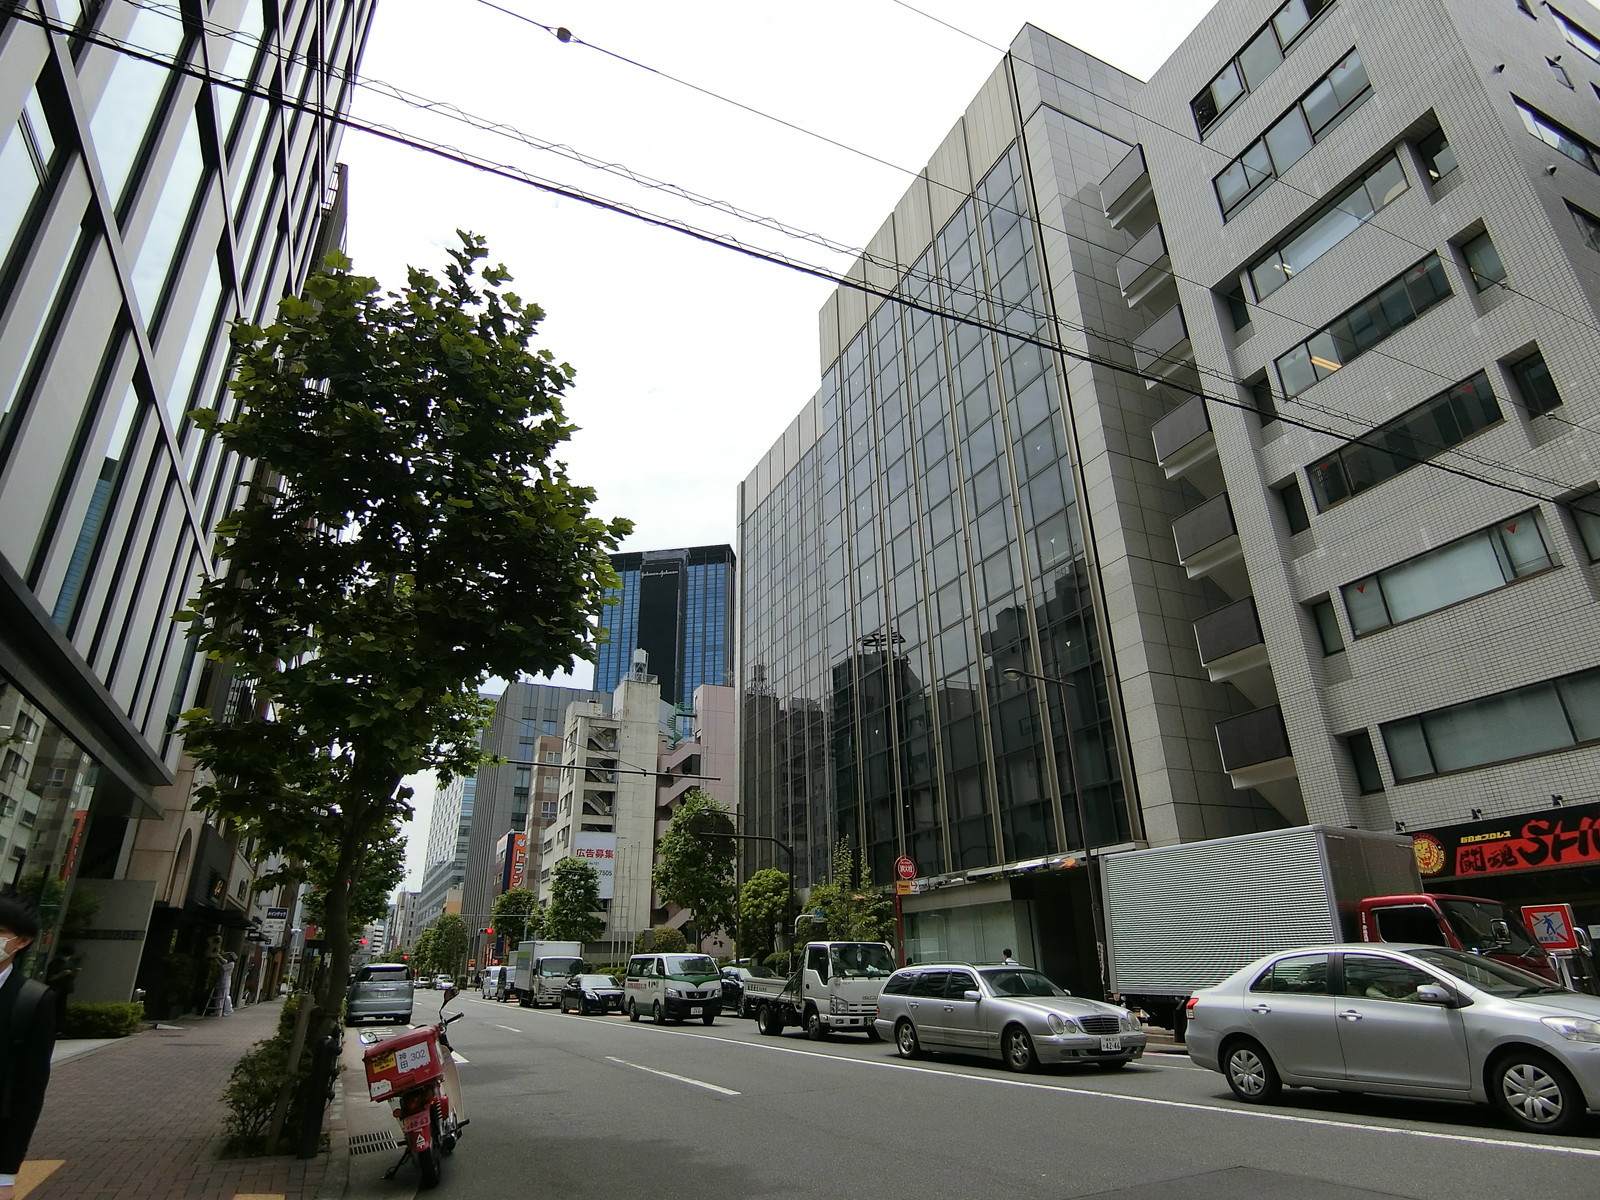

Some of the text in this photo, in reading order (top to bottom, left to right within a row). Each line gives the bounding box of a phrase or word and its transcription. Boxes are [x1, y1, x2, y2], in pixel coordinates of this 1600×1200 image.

[575, 848, 614, 859] 広告募集
[410, 1049, 426, 1061] 302
